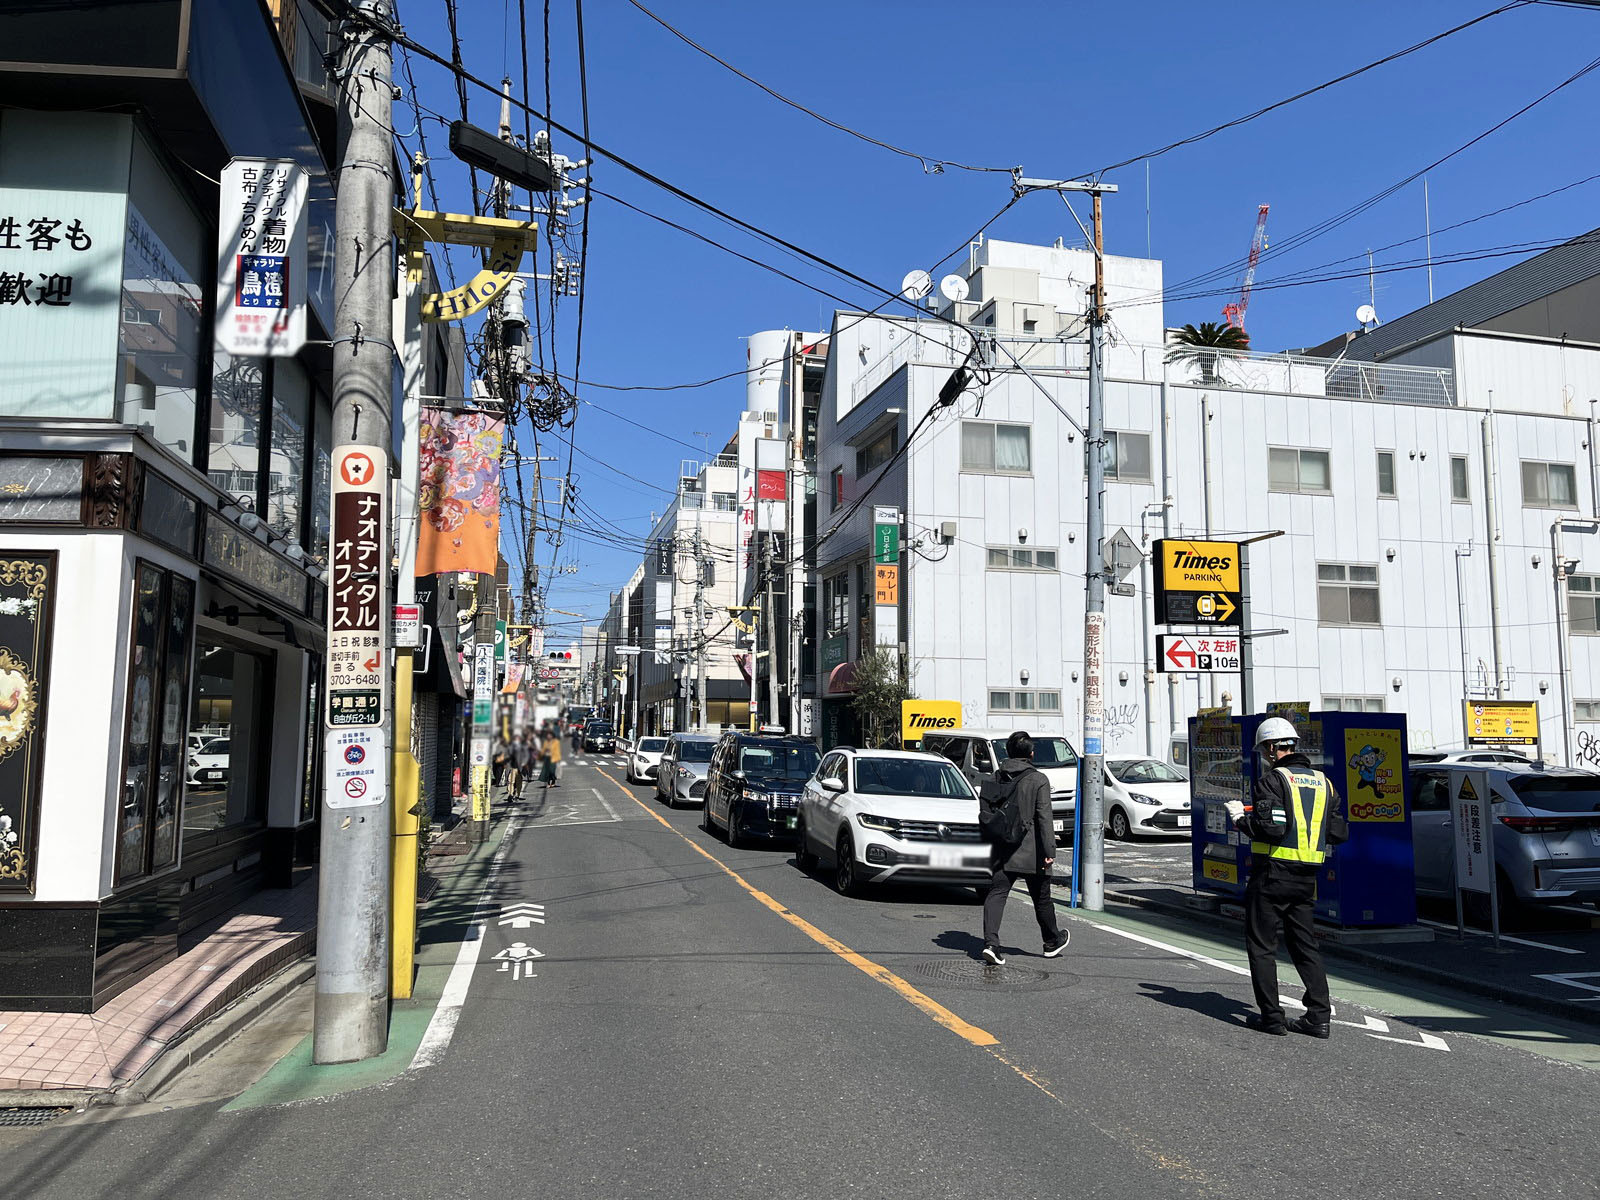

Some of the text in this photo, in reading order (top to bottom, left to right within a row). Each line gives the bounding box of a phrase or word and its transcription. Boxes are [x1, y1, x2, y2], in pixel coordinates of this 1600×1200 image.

[262, 168, 274, 216] アンティーク
[276, 169, 287, 217] リサイクル
[240, 167, 258, 252] 古布・ちりめん
[262, 218, 287, 253] 着物
[244, 258, 283, 268] ギャラリー
[242, 270, 283, 296] 鳥澄
[431, 243, 519, 318] Hilo St.
[356, 496, 378, 627] ナオデンタル
[1173, 551, 1231, 570] Times
[334, 539, 354, 627] オフィス
[877, 569, 886, 601] 専門
[887, 569, 896, 601] カレー
[1184, 573, 1222, 582] PARKING
[1198, 640, 1237, 653] 次 左折
[1086, 624, 1100, 699] 整形外科・眼科
[1214, 657, 1238, 668] 10台
[331, 674, 380, 685] 3703-6480
[331, 696, 378, 708] 学園通り
[333, 714, 376, 725] 自由が丘2-14
[908, 714, 957, 727] Times
[1289, 776, 1322, 786] KITAMURA
[1471, 804, 1482, 854] 段差注意
